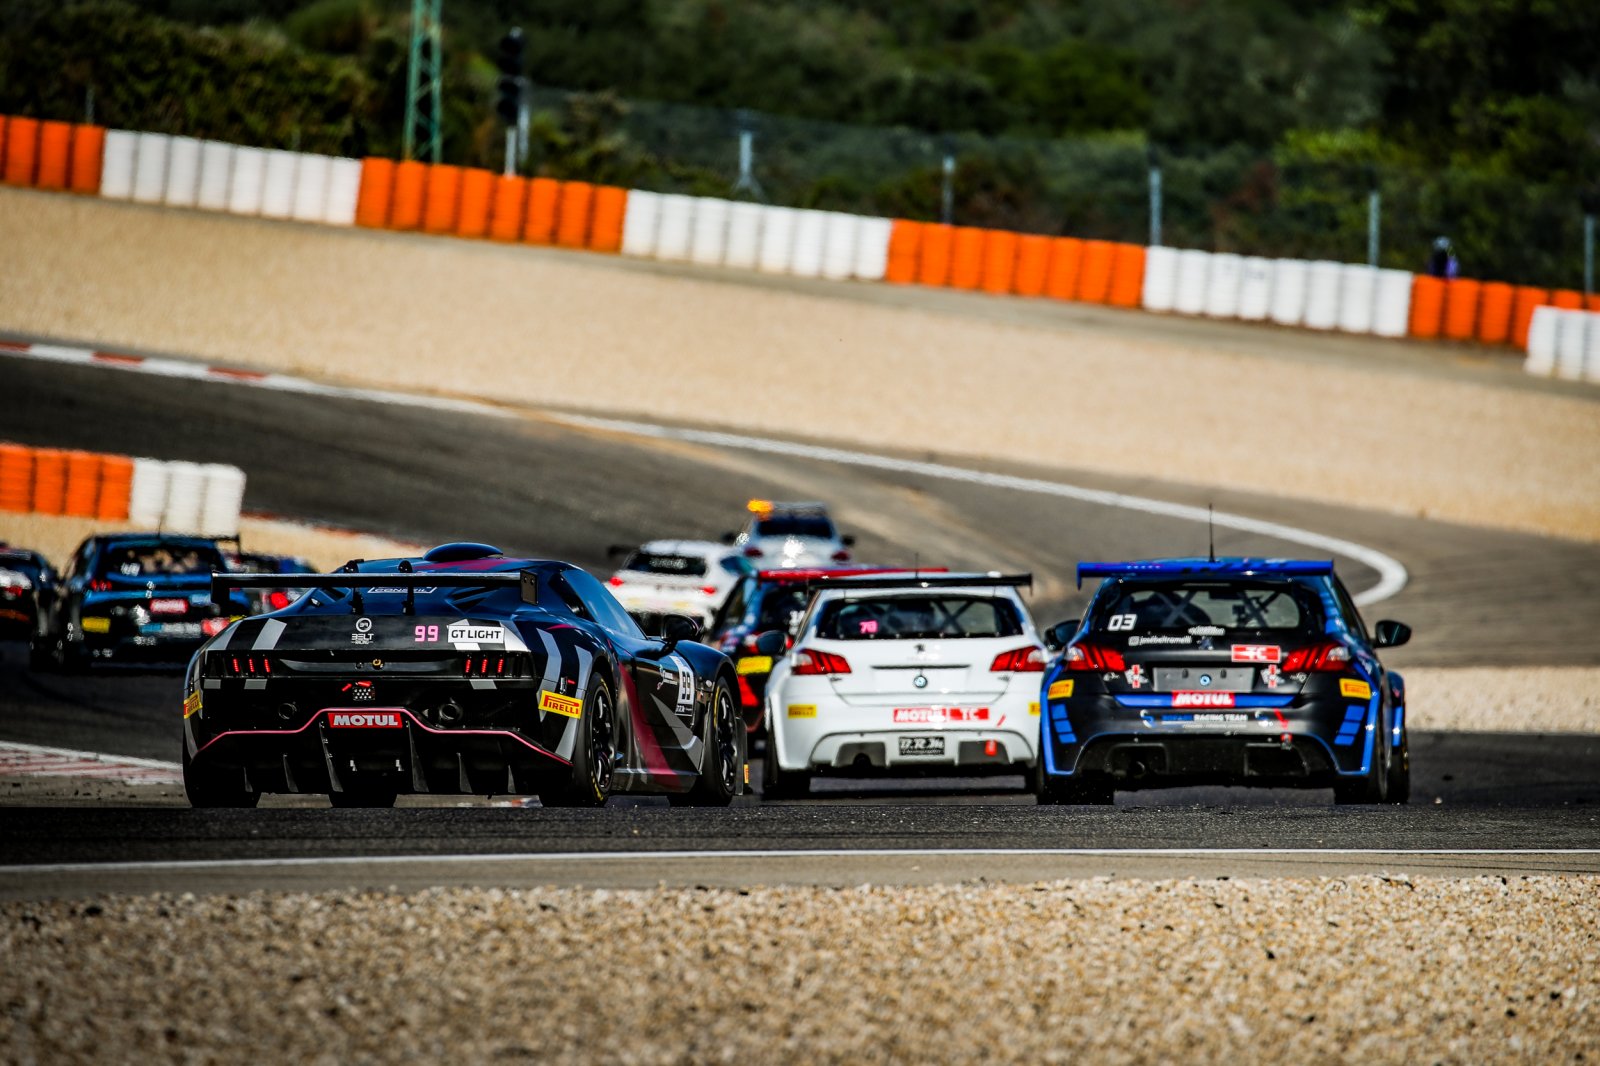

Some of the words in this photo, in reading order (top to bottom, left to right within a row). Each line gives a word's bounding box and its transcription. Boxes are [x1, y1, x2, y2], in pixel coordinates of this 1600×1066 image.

[1107, 614, 1137, 631] 03
[415, 626, 438, 641] 99
[451, 630, 466, 638] GT
[468, 630, 501, 639] LIGHT
[543, 695, 580, 715] PIRELLI
[1174, 693, 1233, 705] MOTUL
[333, 714, 399, 726] MOTUL
